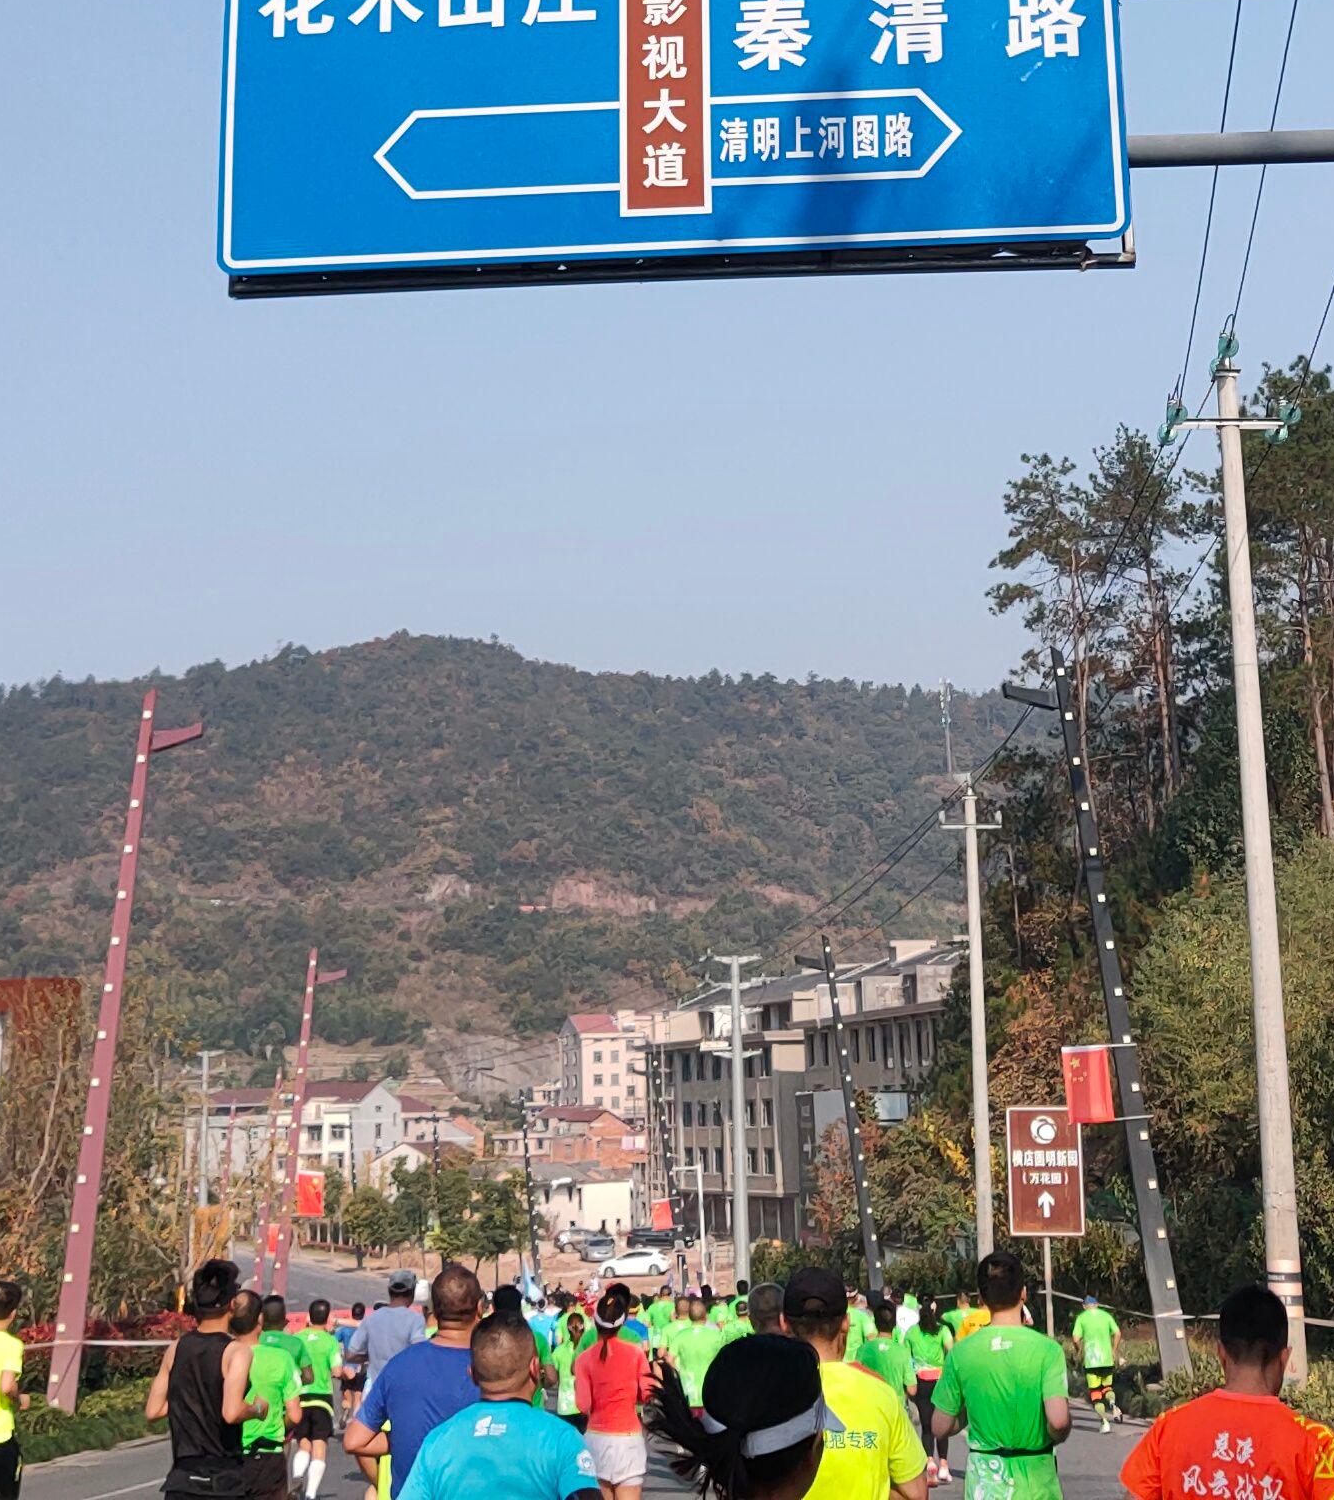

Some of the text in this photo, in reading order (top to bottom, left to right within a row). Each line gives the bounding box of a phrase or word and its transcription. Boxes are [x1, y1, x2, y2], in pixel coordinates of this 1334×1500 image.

[719, 112, 914, 163] 清明上河图路
